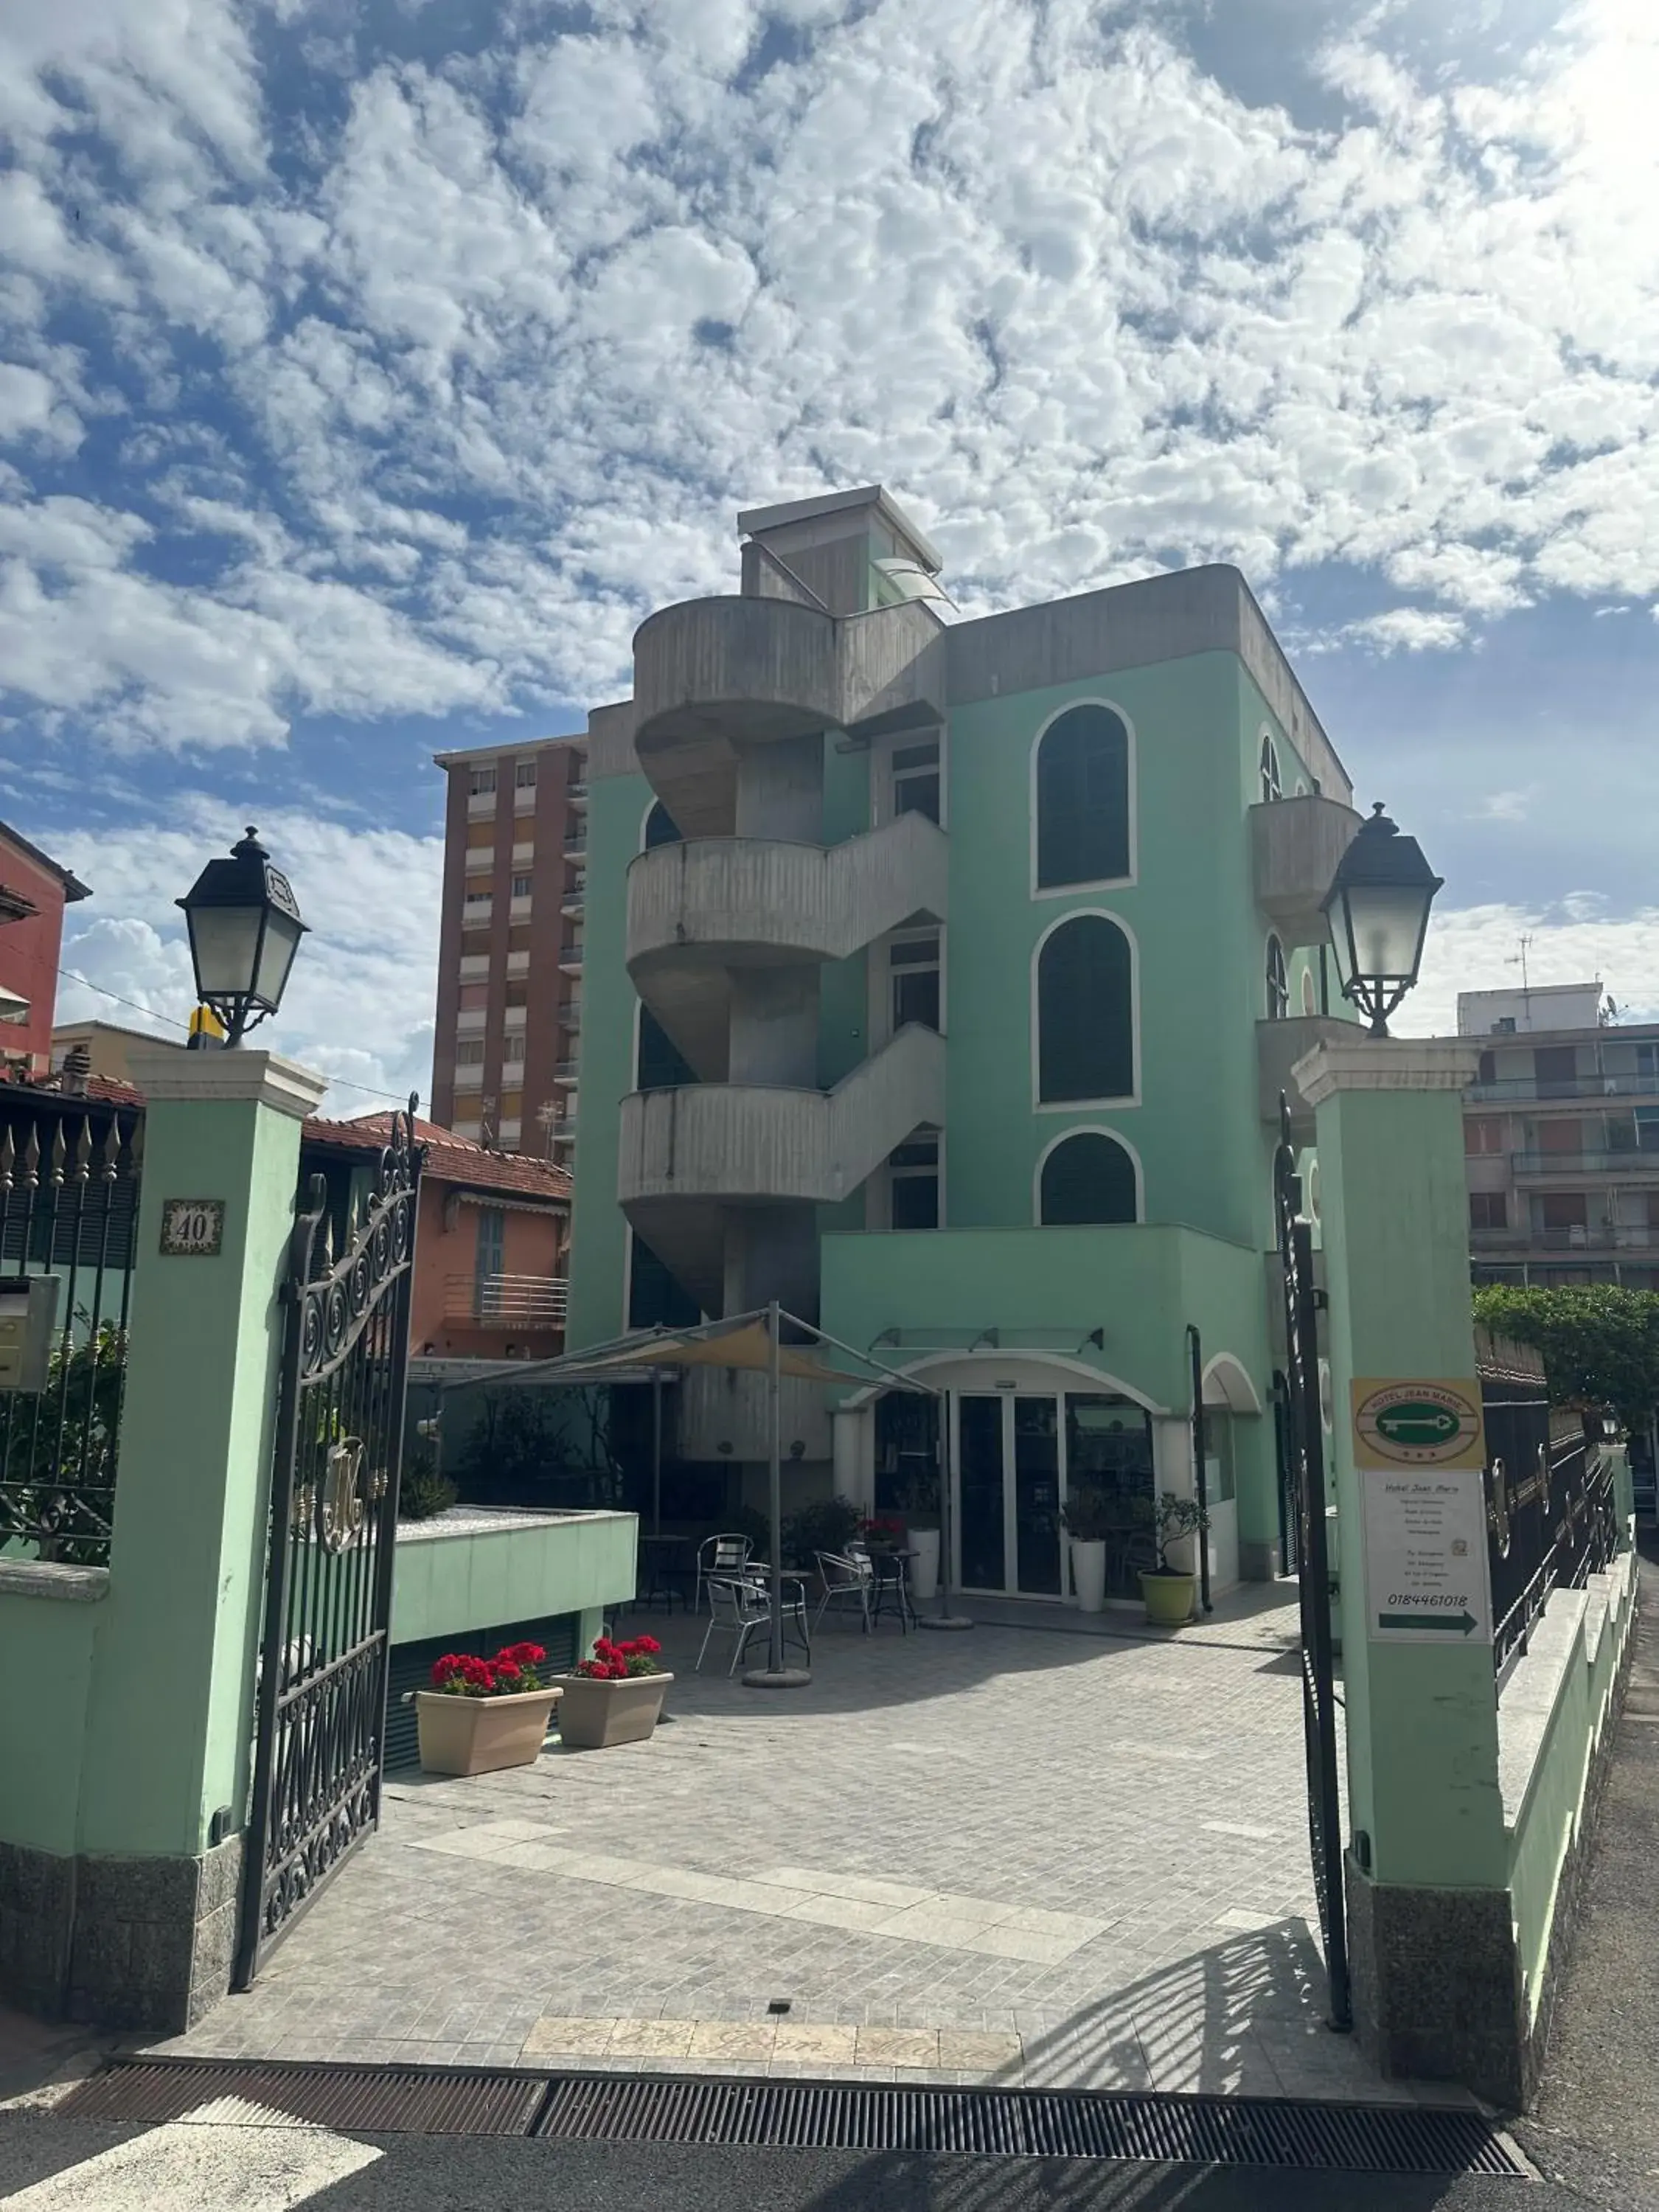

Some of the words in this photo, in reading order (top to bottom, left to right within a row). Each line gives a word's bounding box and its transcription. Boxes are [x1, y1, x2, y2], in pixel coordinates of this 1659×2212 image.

[176, 1214, 207, 1241] 40
[1371, 1393, 1402, 1409] HOTEL
[1405, 1388, 1430, 1399] JEAN
[1433, 1392, 1463, 1410] MARIE
[1388, 1593, 1468, 1607] 0184461018
